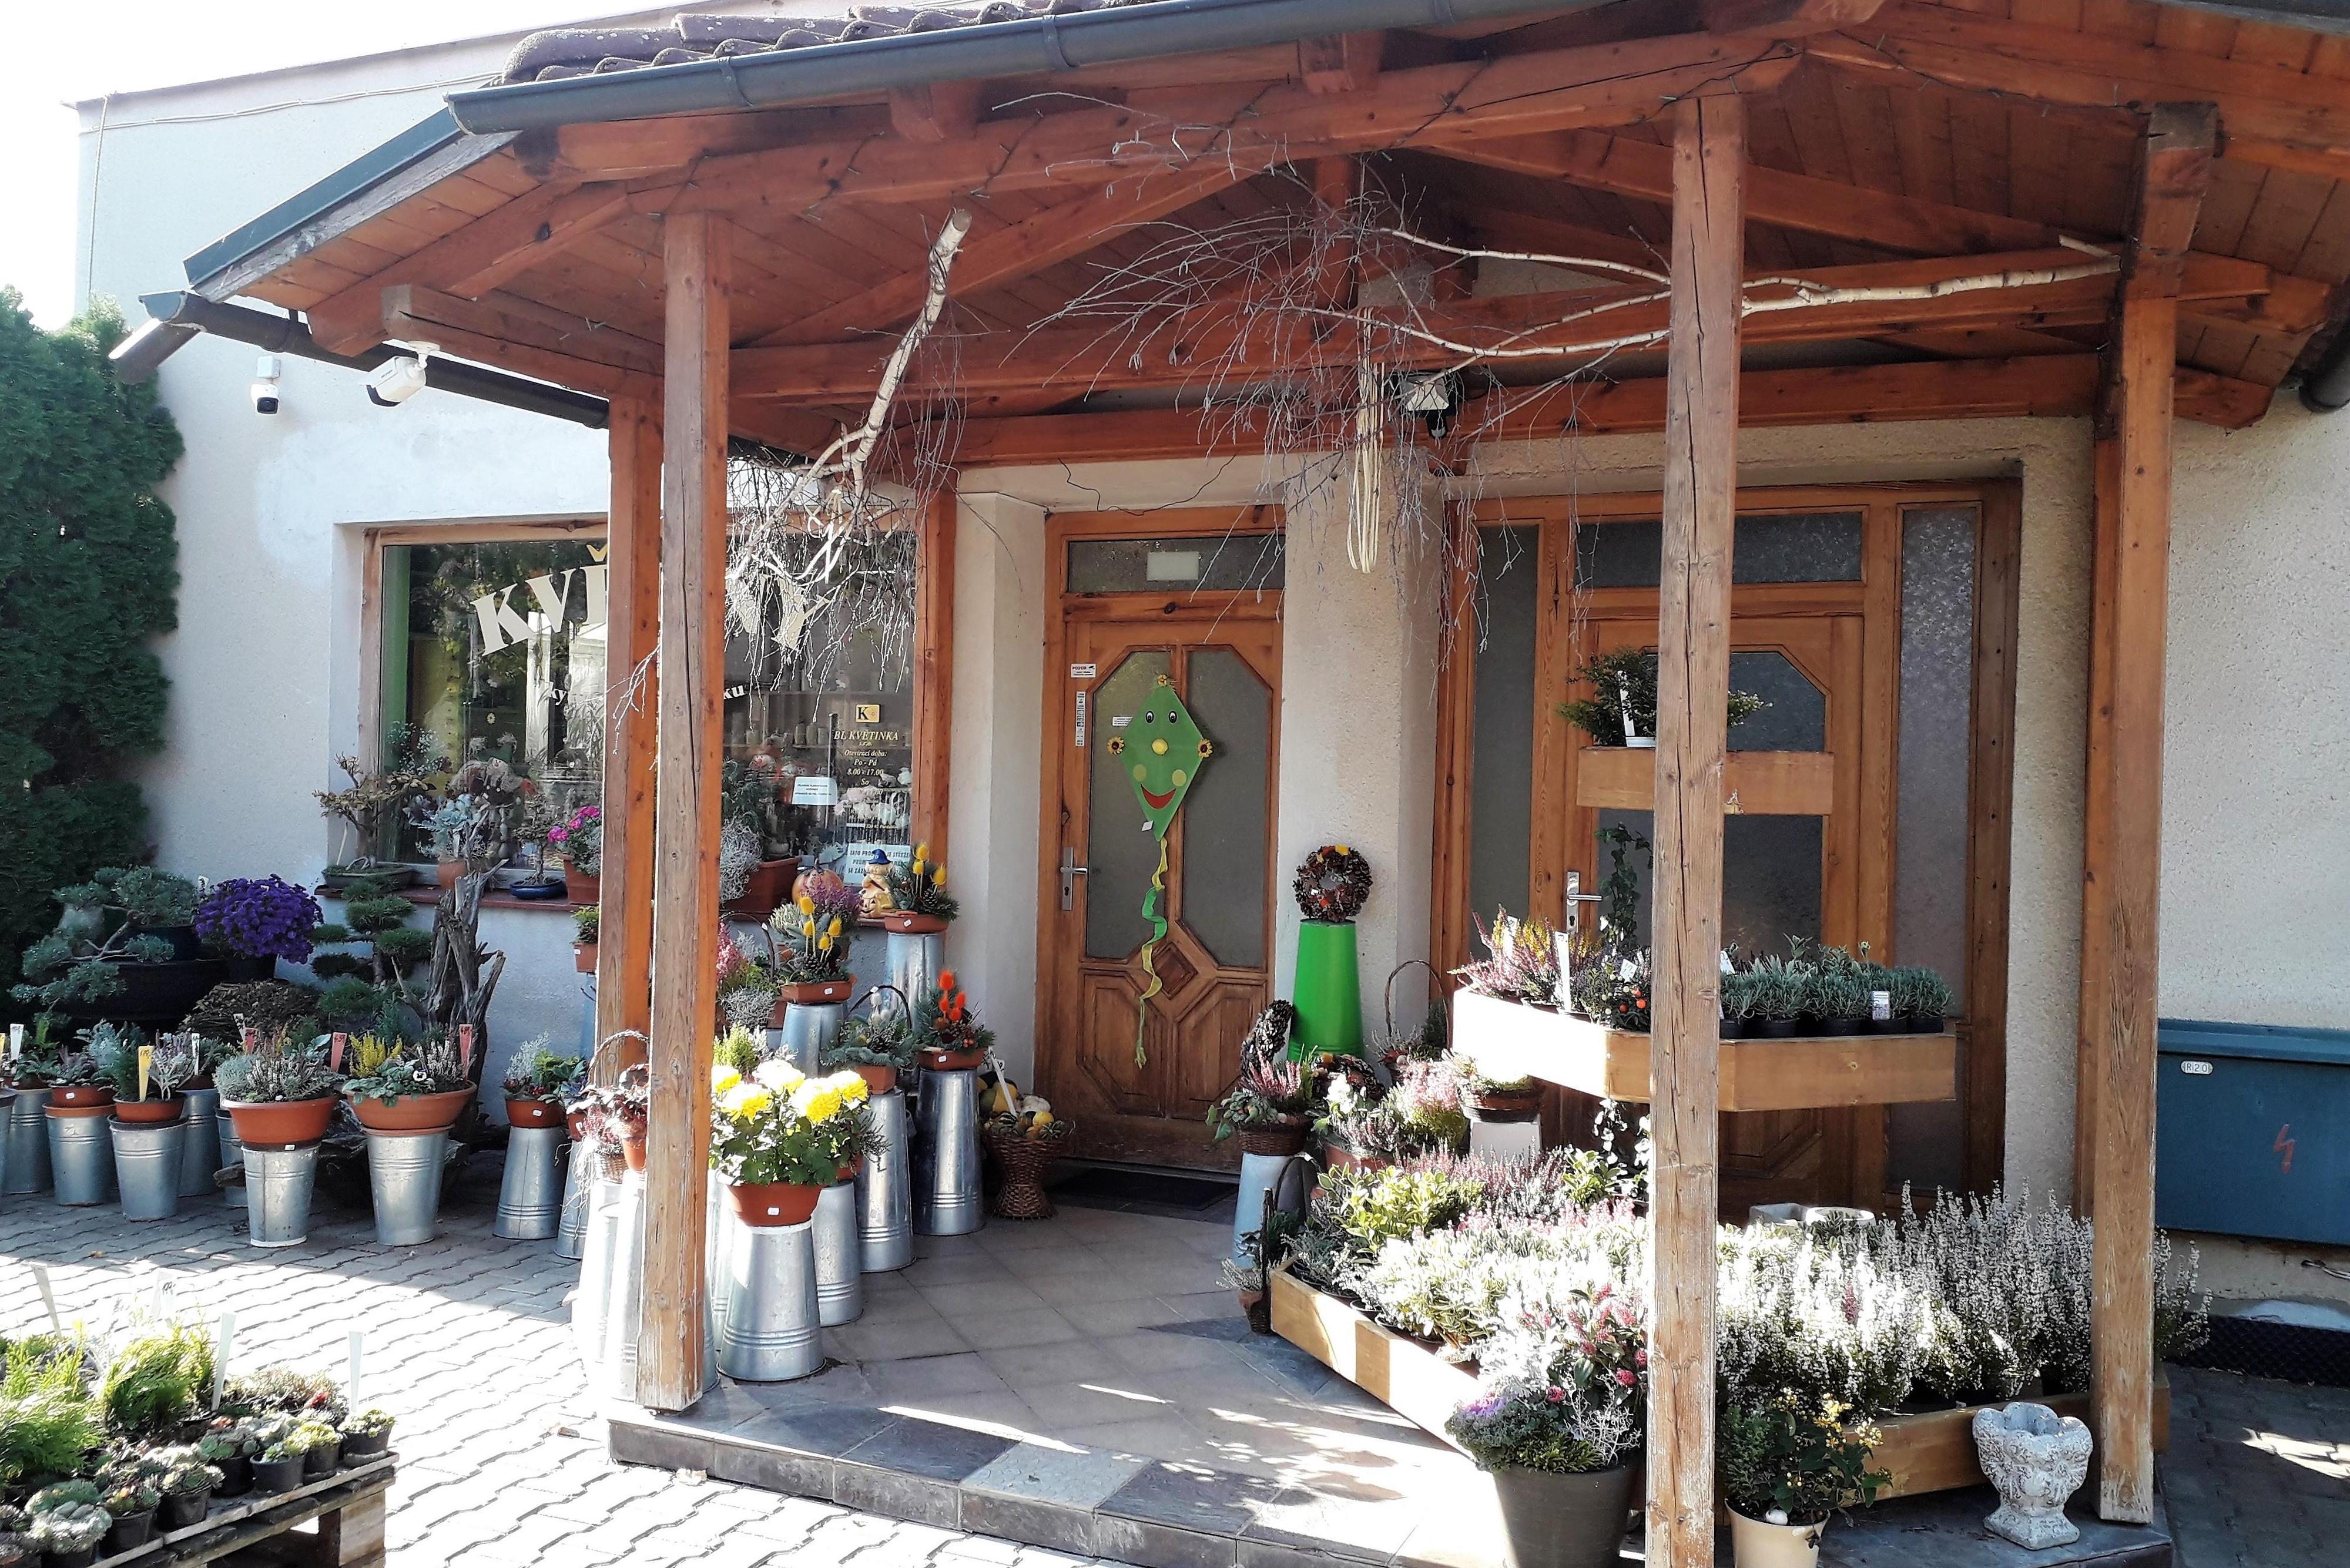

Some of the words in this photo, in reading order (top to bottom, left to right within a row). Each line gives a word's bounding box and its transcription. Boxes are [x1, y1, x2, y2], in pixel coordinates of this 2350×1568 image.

[857, 707, 869, 720] K
[834, 731, 847, 740] BL
[849, 729, 899, 740] KVĚTINKA
